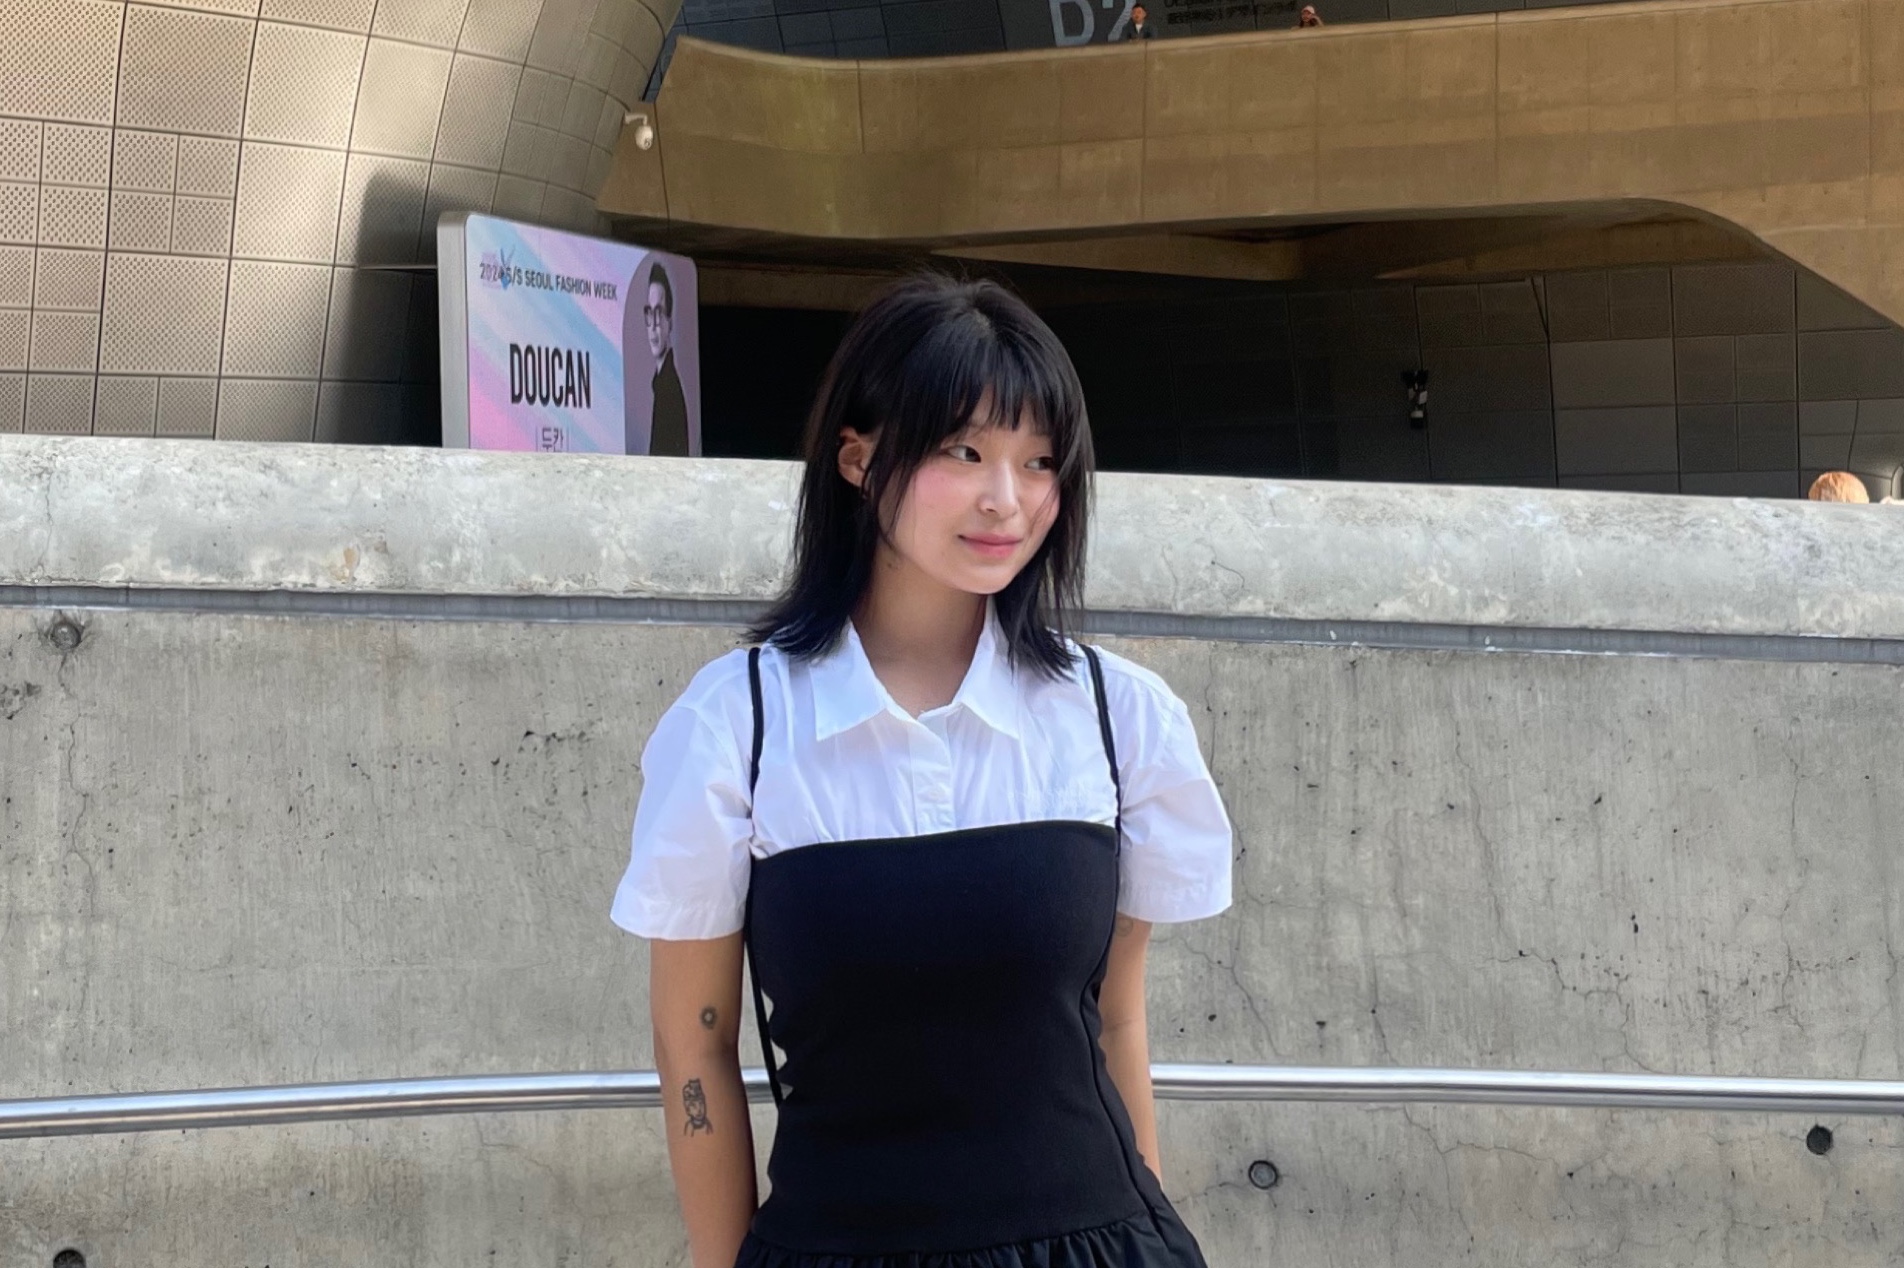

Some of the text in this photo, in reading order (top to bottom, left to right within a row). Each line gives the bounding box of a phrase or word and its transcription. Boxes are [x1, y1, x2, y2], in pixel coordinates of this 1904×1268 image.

[524, 270, 554, 291] SEOUL
[556, 275, 592, 298] FASHION
[593, 282, 618, 301] WEEK
[510, 343, 591, 410] DOUCAN
[541, 427, 564, 452] 두칸
